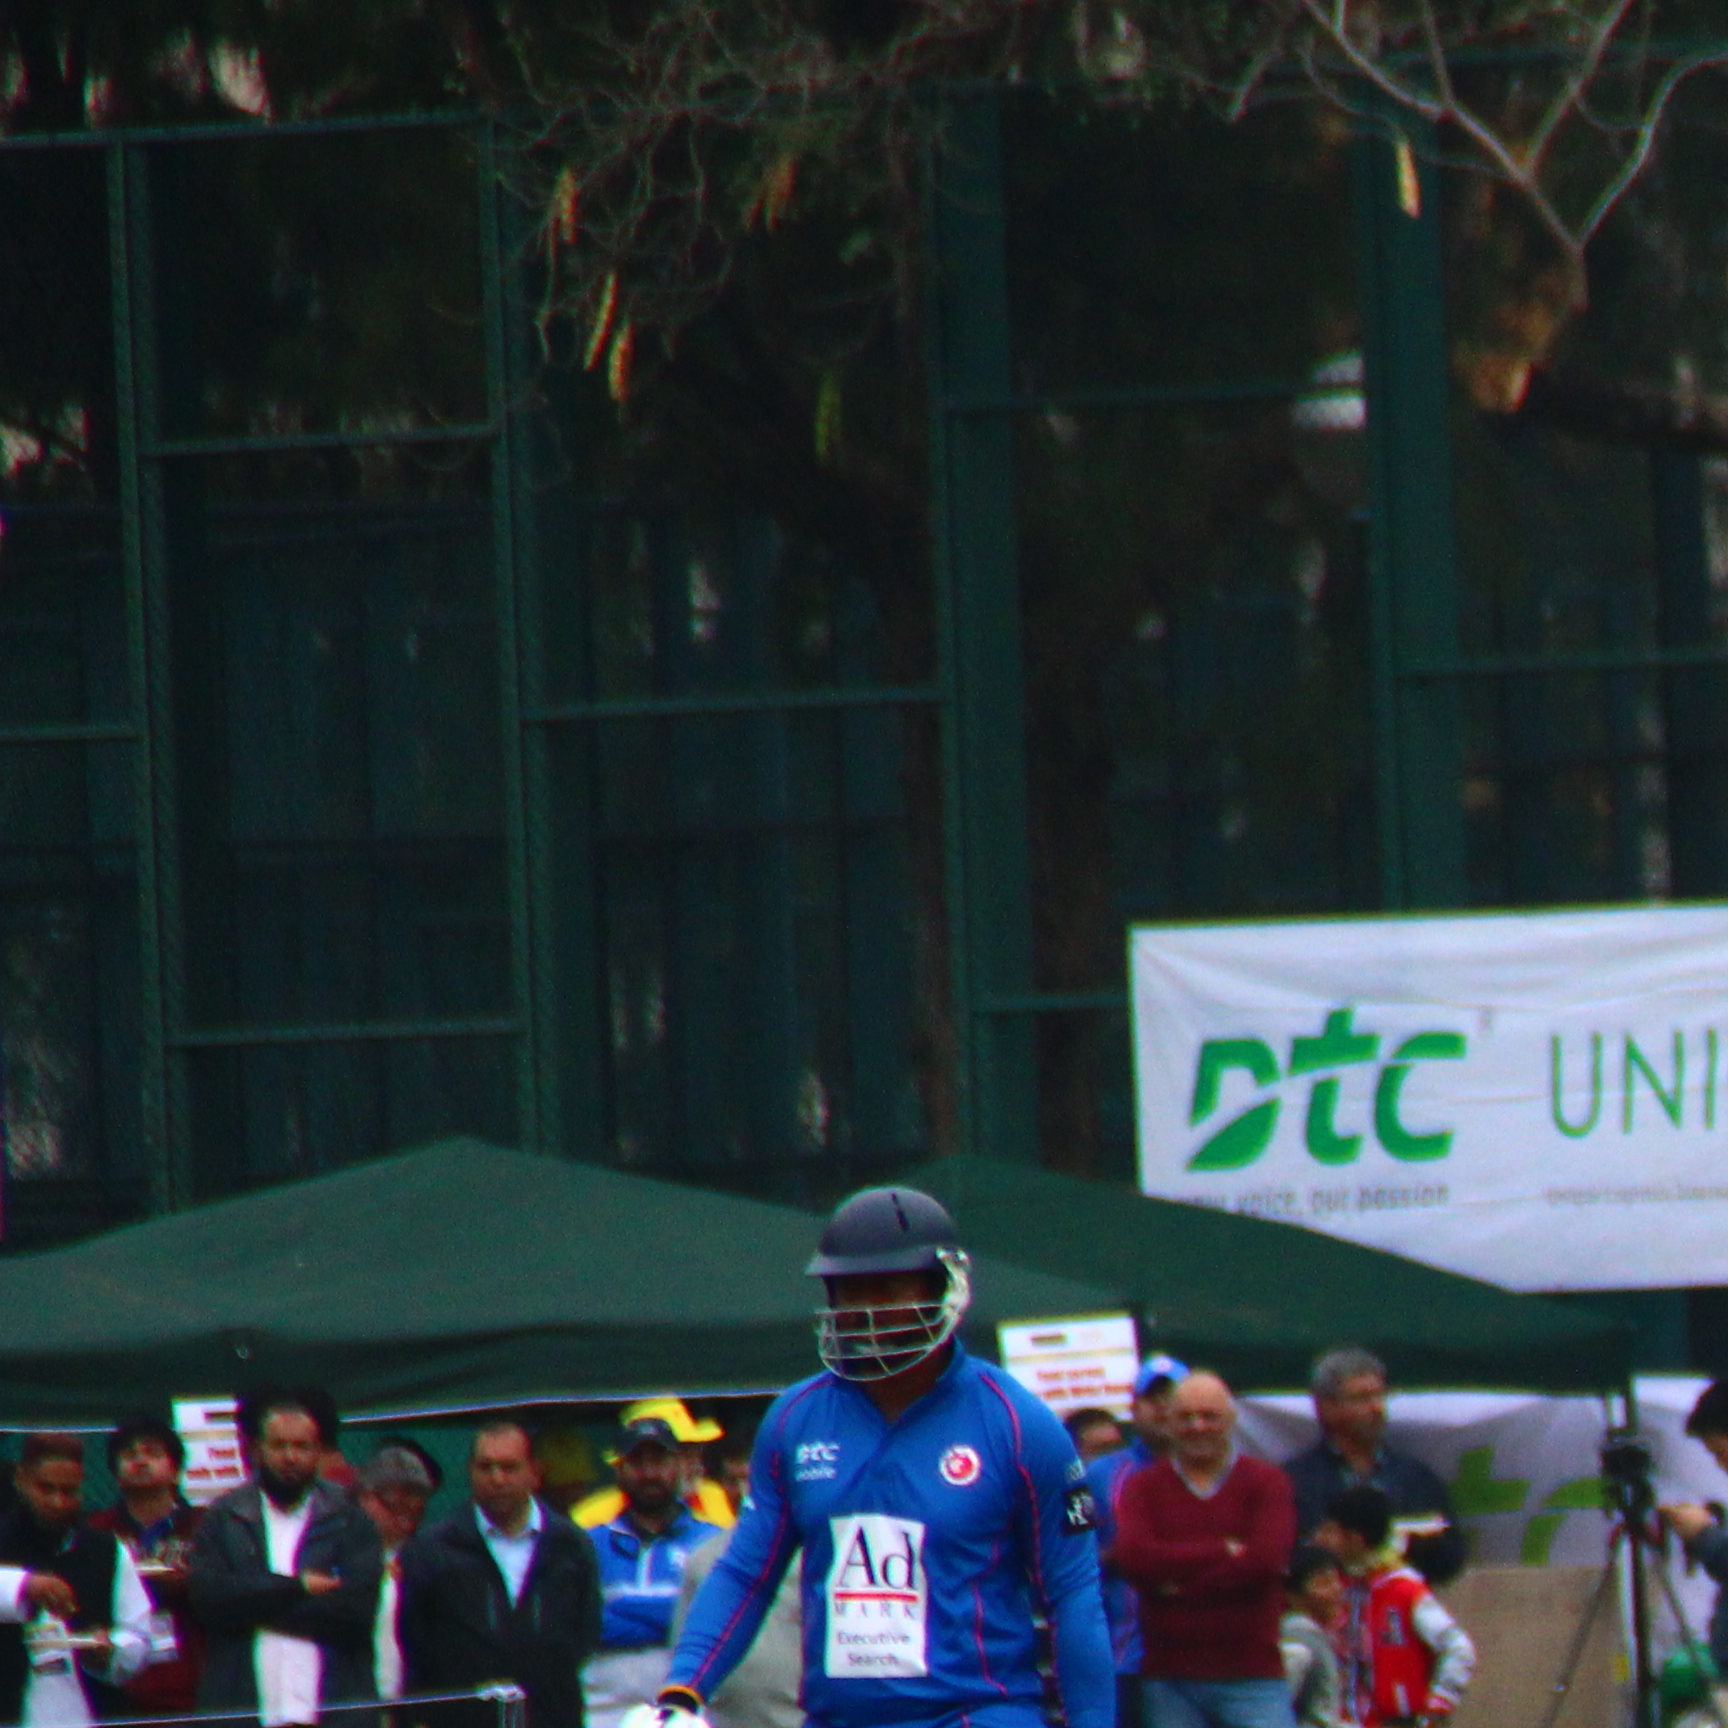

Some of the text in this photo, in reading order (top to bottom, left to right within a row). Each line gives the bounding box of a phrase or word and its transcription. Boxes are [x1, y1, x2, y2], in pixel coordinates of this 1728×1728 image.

[835, 1525, 917, 1591] Ad
[836, 1630, 911, 1646] Executive
[848, 1652, 900, 1667] Search
